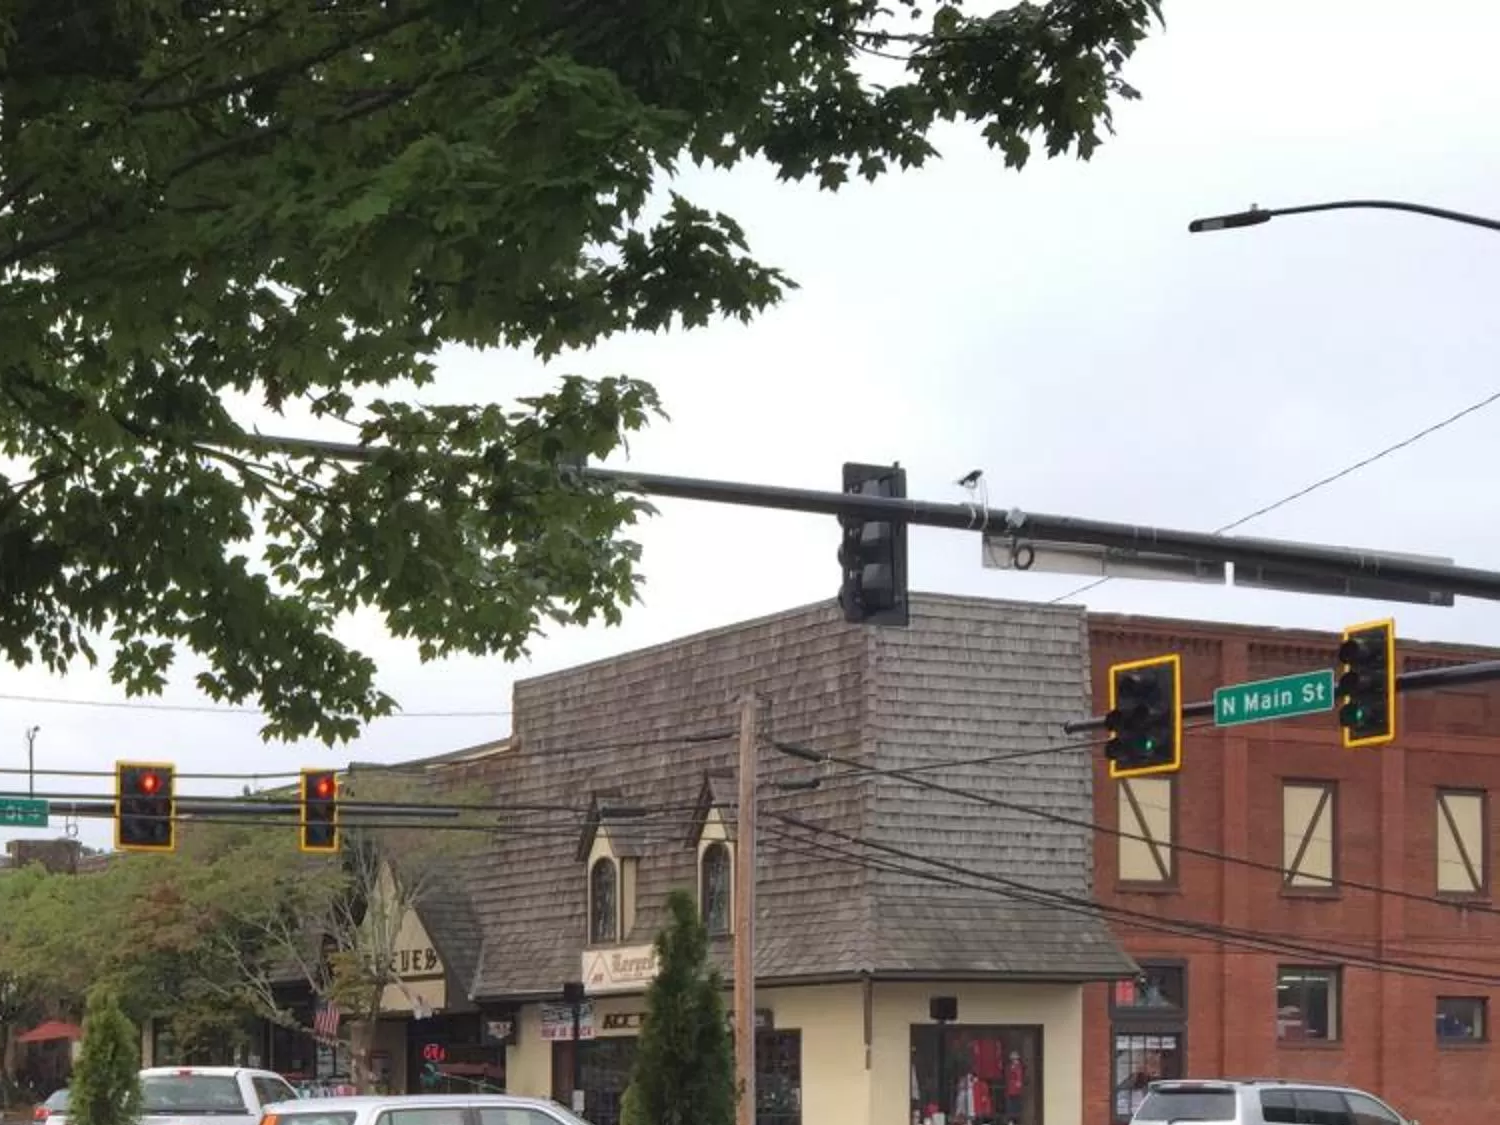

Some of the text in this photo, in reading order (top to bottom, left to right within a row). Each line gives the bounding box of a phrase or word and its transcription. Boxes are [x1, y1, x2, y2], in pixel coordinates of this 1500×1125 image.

[1222, 683, 1324, 716] N Main St
